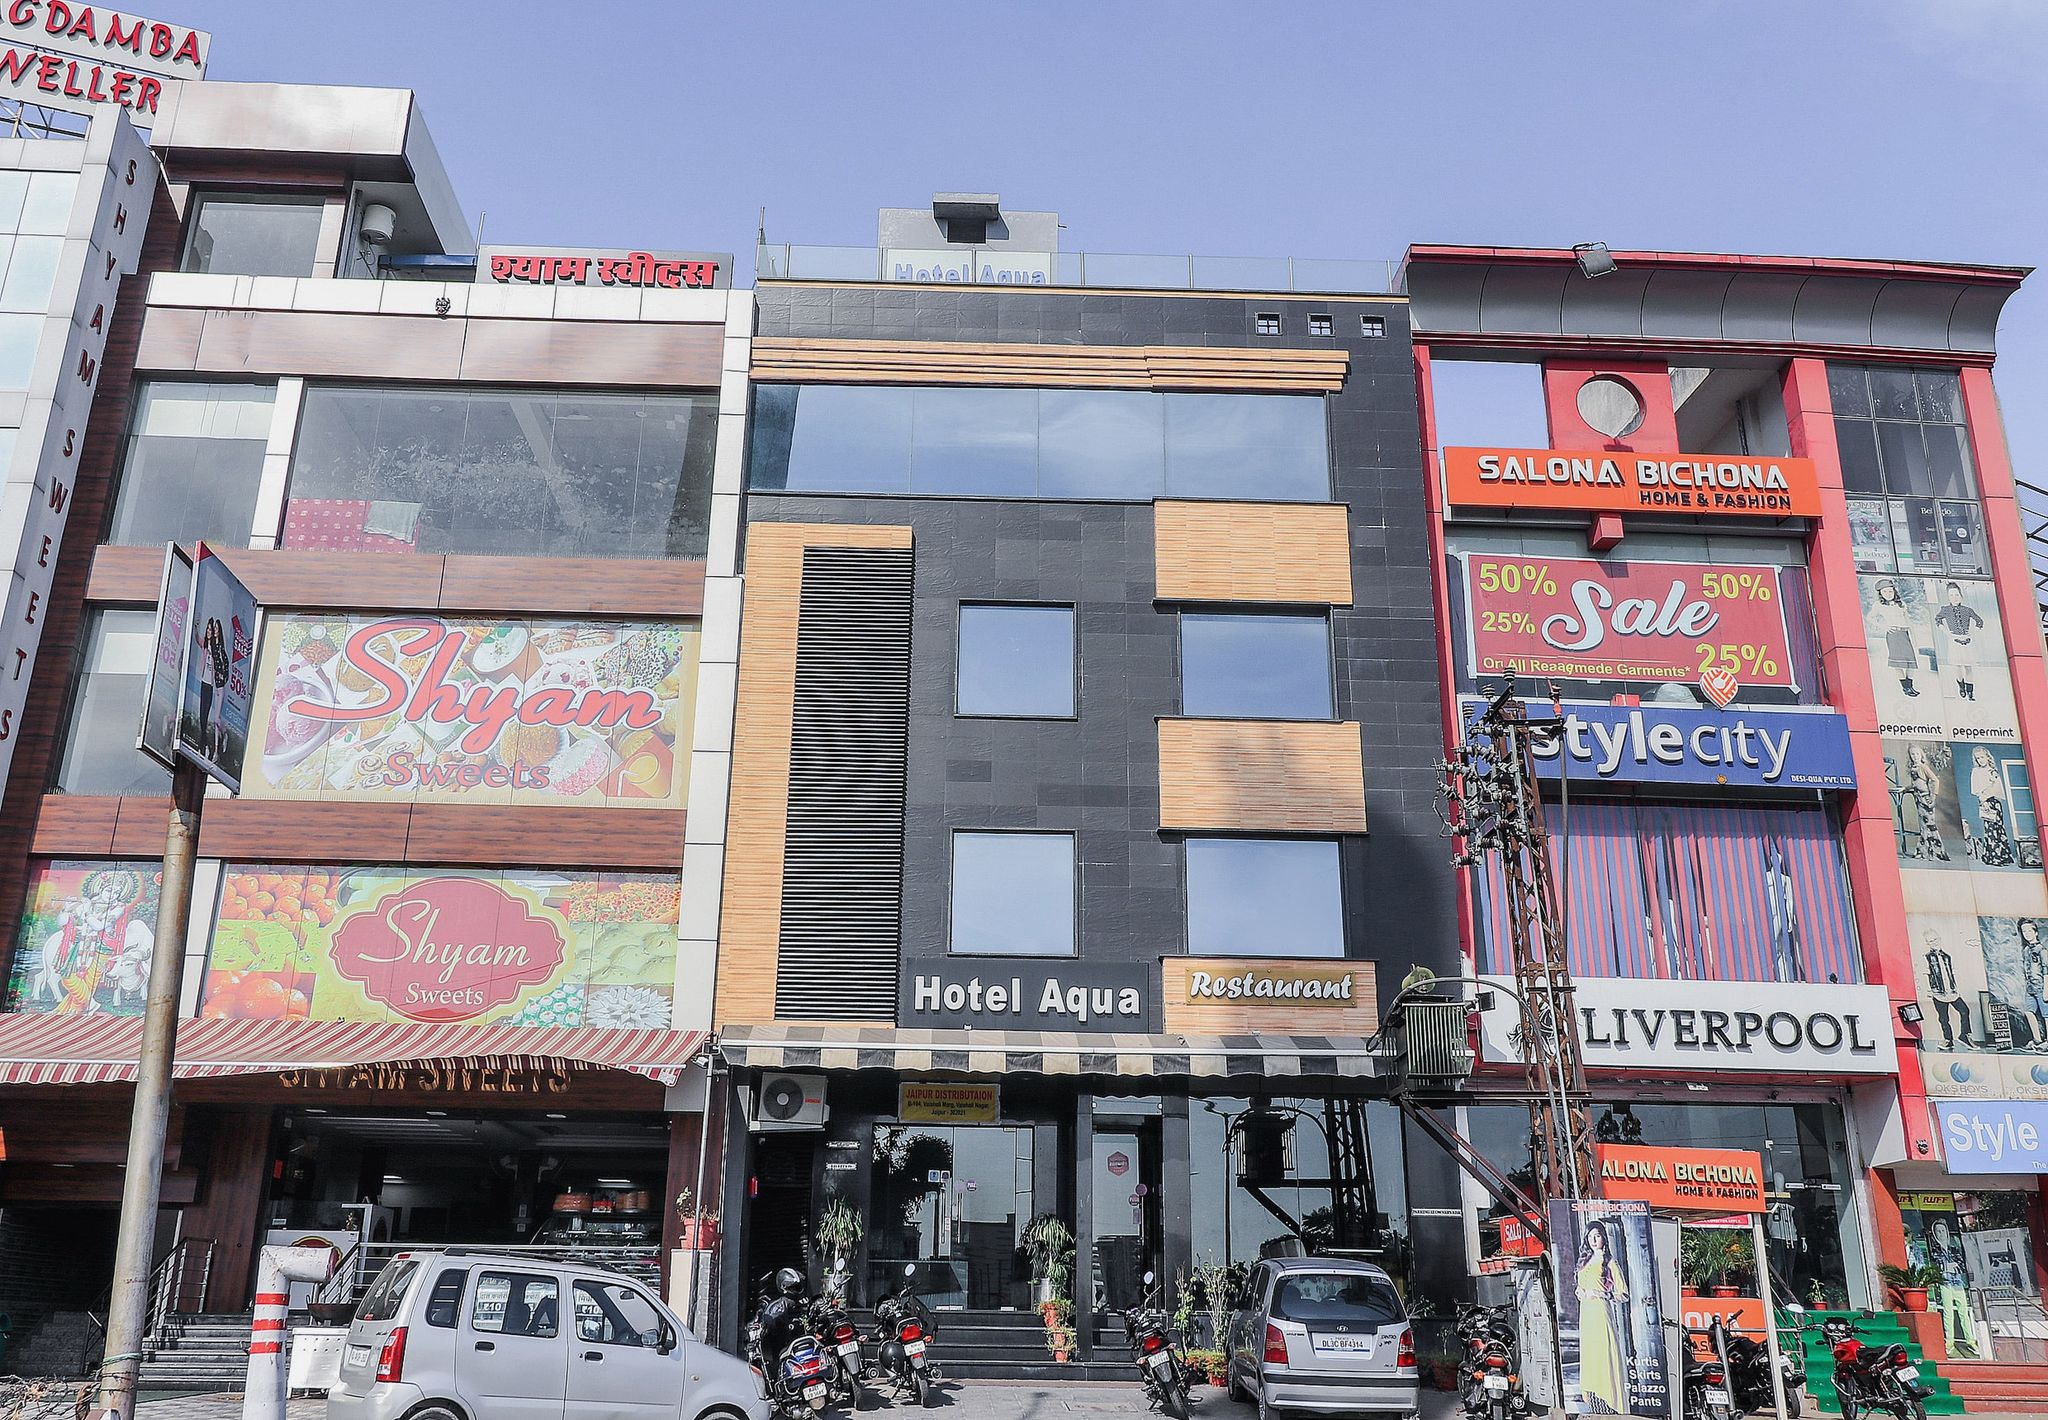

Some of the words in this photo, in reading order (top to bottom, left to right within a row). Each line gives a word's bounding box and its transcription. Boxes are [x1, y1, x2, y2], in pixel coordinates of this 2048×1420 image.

[0, 0, 201, 66] GDAMBA
[77, 159, 138, 387] SHYAM
[895, 263, 970, 283] Hotel
[979, 264, 1047, 285] Aqua
[1478, 455, 1624, 487] SALONA
[1635, 461, 1789, 492] BICHONA
[1639, 490, 1692, 507] HOME
[1695, 491, 1710, 507] &
[1713, 494, 1791, 509] FASHION
[0, 429, 76, 742] SWEETS
[1479, 562, 1558, 597] 50%
[1701, 572, 1772, 602] 50%
[1481, 611, 1537, 635] 25%
[1540, 578, 1720, 652] Sale
[1508, 658, 1526, 673] All
[1695, 643, 1778, 677] 25%
[288, 618, 662, 755] Shyam
[1880, 723, 1942, 736] peppermint
[1952, 727, 2015, 739] peppermint
[383, 751, 550, 790] Sweets
[357, 899, 531, 984] Shyam
[404, 982, 484, 1006] Sweets
[1190, 971, 1352, 1000] Restaurant
[914, 975, 1021, 1013] Hotel
[1038, 978, 1140, 1022] Aqua
[1579, 1006, 1877, 1052] LIVERPOOL
[906, 1089, 933, 1099] JAIPUR
[1935, 1084, 1958, 1094] OKS
[1959, 1085, 1989, 1094] BOYS
[1946, 1112, 2039, 1161] Style
[1601, 1159, 1668, 1180] ALONA
[1674, 1162, 1758, 1186] BICHONA
[2032, 1161, 2047, 1169] The
[1675, 1186, 1704, 1198] HOME
[1716, 1187, 1759, 1200] FASHION
[1608, 1203, 1647, 1212] BICHONA
[1625, 1356, 1659, 1367] Kurtis
[1629, 1369, 1661, 1380] Skirts
[1624, 1382, 1666, 1393] Palazzo
[1630, 1396, 1662, 1407] Pants
